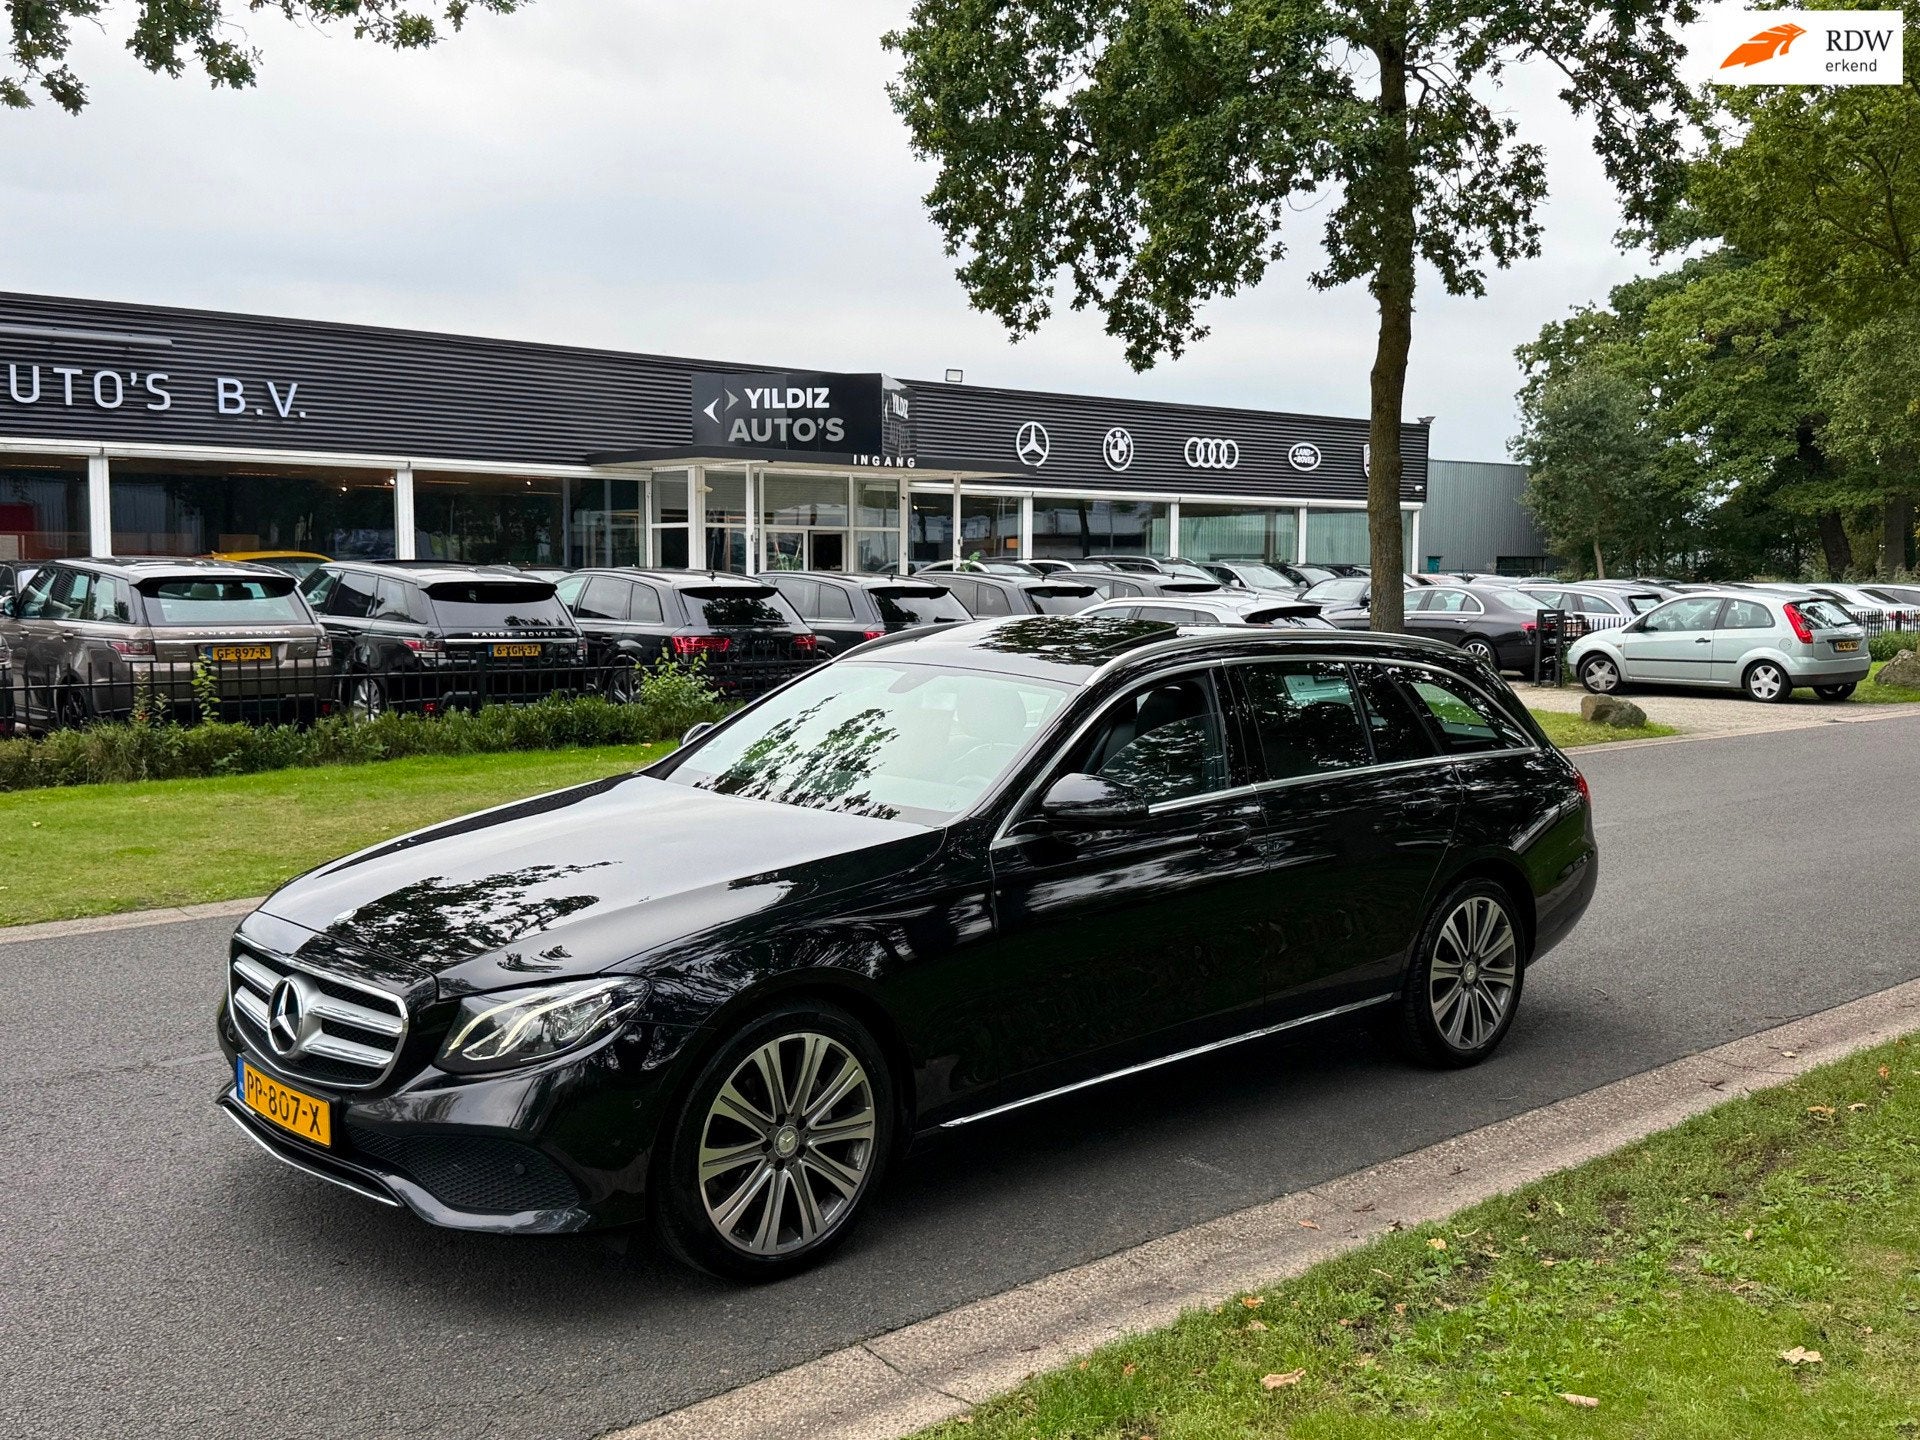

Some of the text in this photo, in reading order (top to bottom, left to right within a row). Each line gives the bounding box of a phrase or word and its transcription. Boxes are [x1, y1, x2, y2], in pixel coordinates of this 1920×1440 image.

[9, 363, 307, 419] UTO'S B.V.
[744, 387, 830, 409] YILDIZ
[728, 417, 845, 443] AUTO'S
[853, 453, 916, 468] INGANG
[216, 647, 267, 659] GF-897-R
[246, 1069, 322, 1136] PP-807-X
